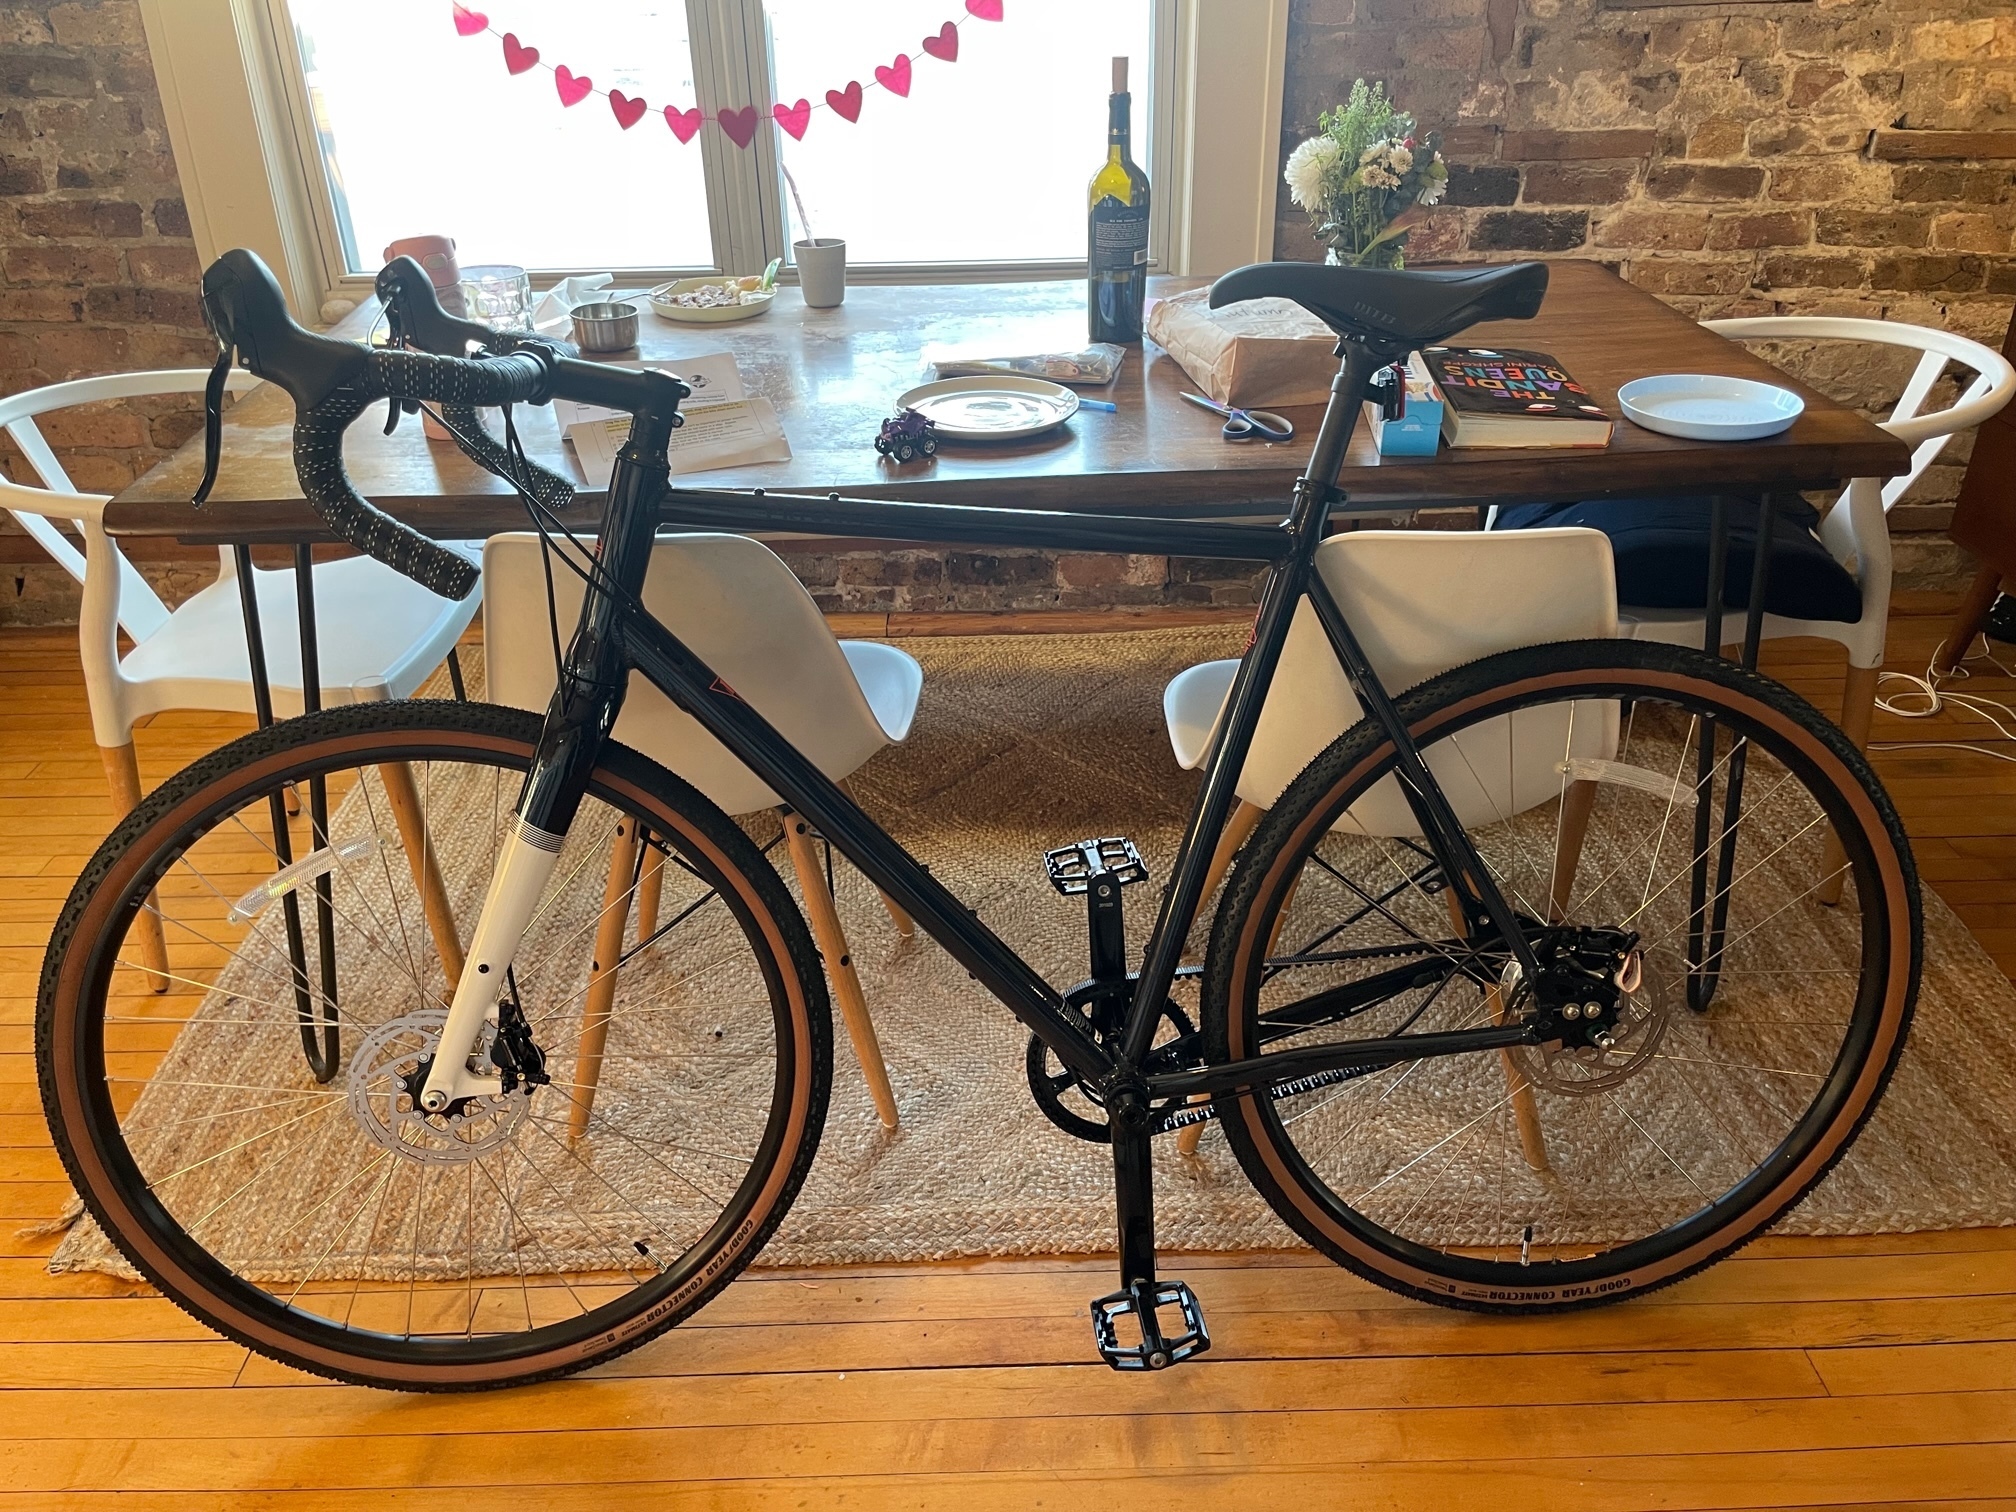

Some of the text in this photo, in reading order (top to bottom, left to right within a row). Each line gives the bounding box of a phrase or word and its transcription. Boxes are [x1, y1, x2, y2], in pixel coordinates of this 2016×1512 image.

[1444, 365, 1568, 382] QUEENS
[1506, 362, 1557, 371] PARINI
[1441, 375, 1588, 395] BANDIT
[1491, 389, 1556, 400] THE
[706, 1219, 753, 1276] GOODYEAR
[1489, 1290, 1556, 1300] CONNECTOR
[1562, 1278, 1631, 1298] GOODYEAR
[646, 1277, 703, 1322] CONNECTOR
